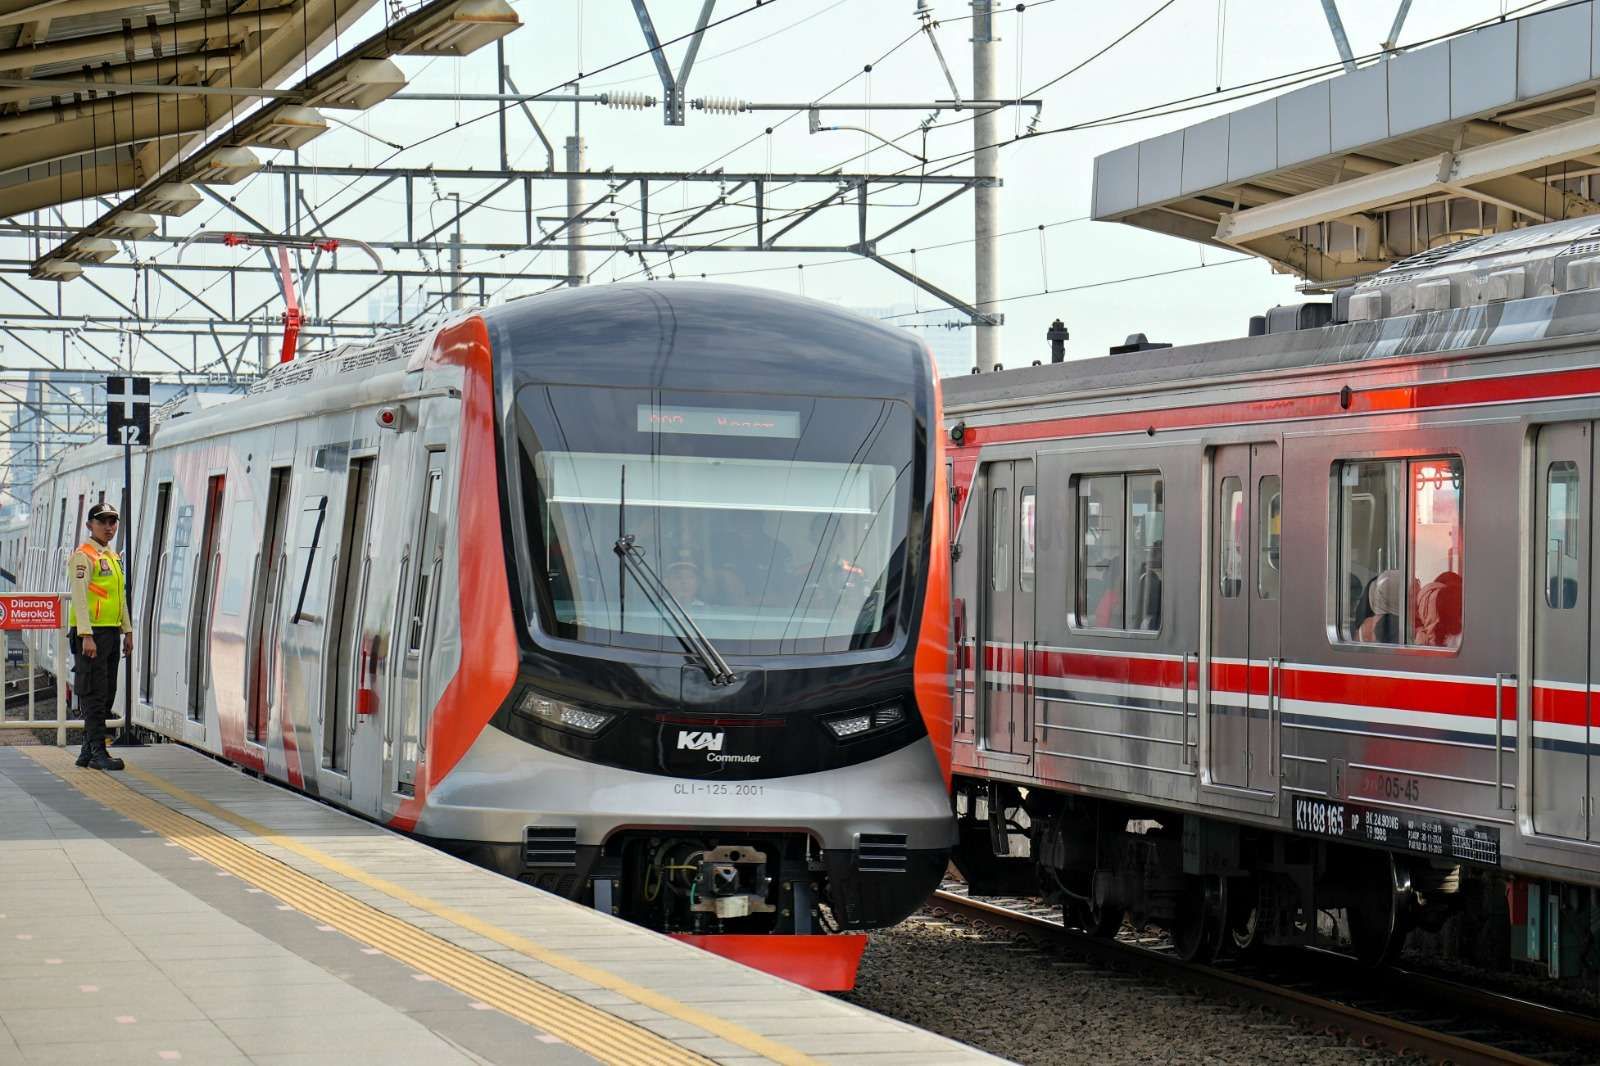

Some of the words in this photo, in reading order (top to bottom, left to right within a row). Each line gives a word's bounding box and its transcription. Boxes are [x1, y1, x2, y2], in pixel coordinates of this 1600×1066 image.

[118, 425, 140, 445] 12
[11, 599, 54, 609] Dilarang
[11, 609, 55, 618] Merokok
[677, 730, 724, 751] KAI
[706, 752, 761, 763] Commuter
